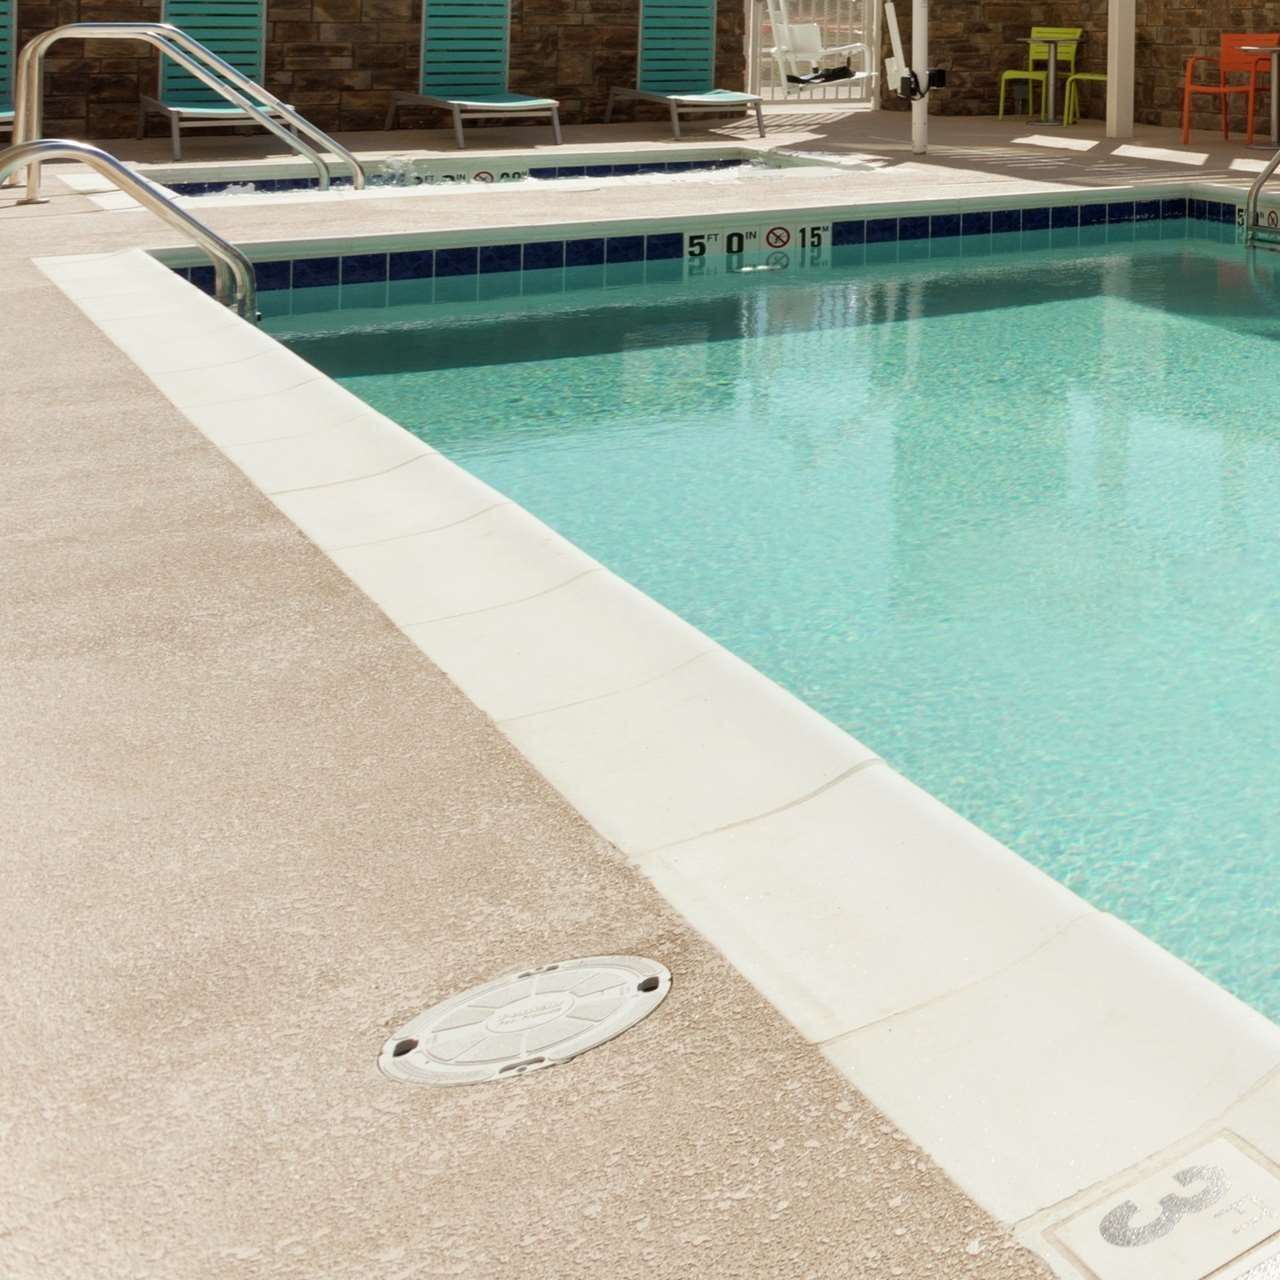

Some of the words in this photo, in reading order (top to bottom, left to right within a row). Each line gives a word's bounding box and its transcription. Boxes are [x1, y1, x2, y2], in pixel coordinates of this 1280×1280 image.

[688, 234, 706, 257] 5
[707, 233, 720, 242] FT
[726, 232, 744, 254] 0
[745, 231, 757, 240] IN
[1099, 1164, 1232, 1249] 3
